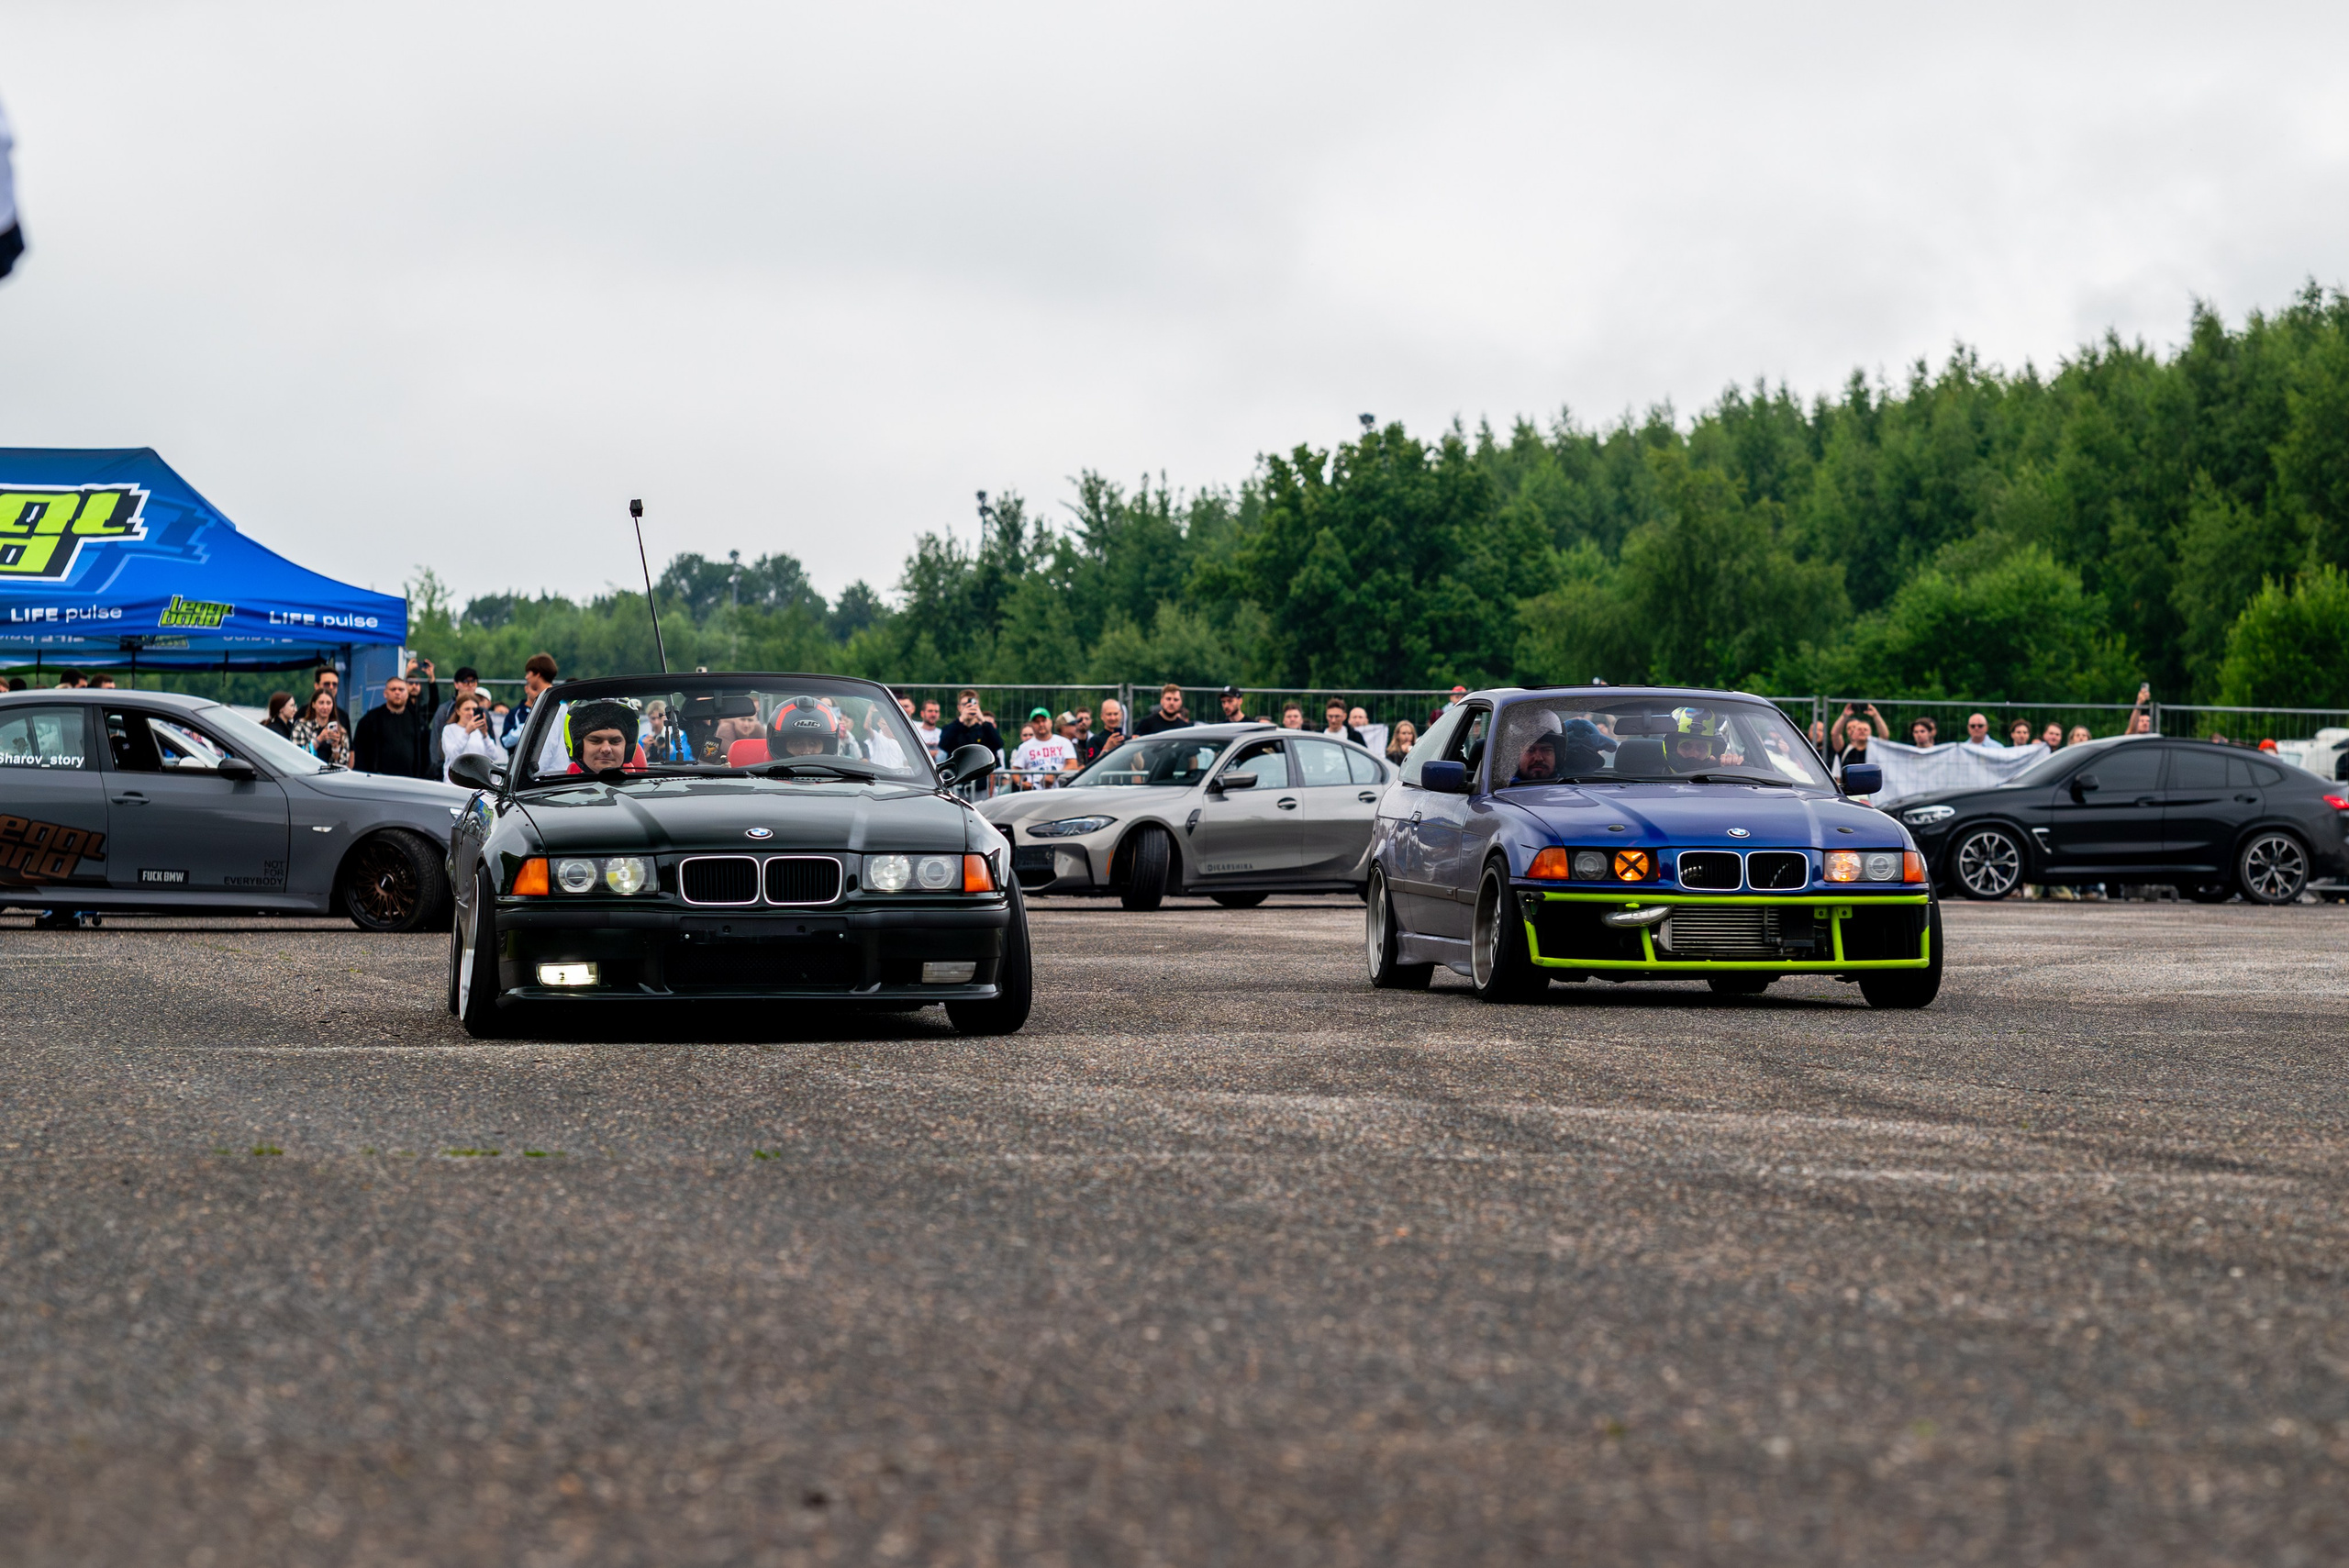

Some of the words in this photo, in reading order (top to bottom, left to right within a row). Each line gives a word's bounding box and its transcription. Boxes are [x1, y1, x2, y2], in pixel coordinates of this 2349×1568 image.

[10, 607, 59, 622] LIFE
[65, 604, 122, 624] pulse
[269, 611, 316, 626] LIFE
[322, 613, 378, 628] pulse
[264, 860, 285, 869] NOT
[142, 871, 162, 882] FUCK
[163, 871, 184, 883] BMW
[264, 869, 284, 877] FOR
[224, 875, 284, 886] EVERYBODY
